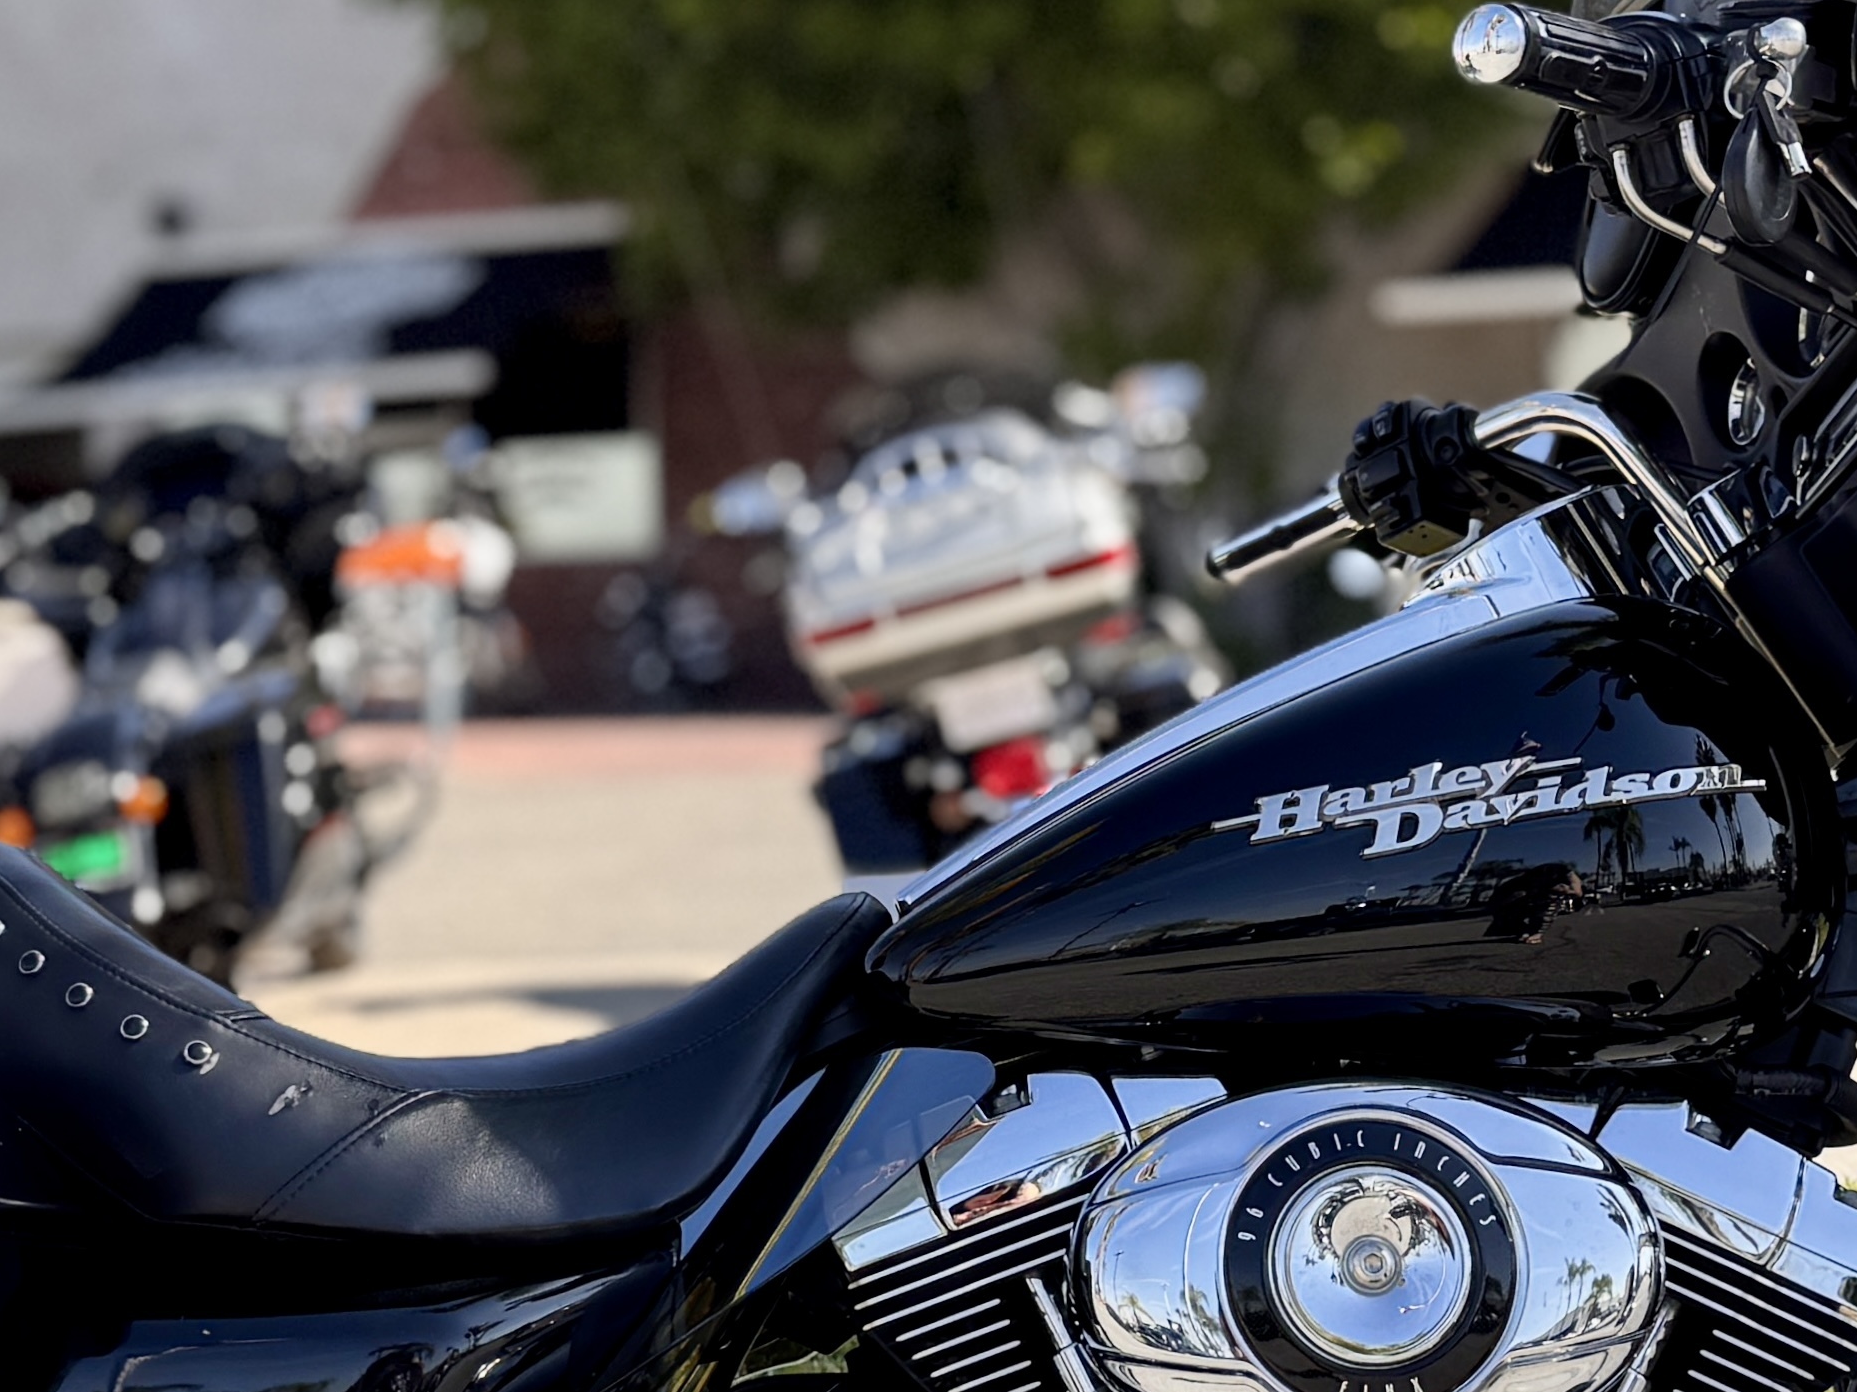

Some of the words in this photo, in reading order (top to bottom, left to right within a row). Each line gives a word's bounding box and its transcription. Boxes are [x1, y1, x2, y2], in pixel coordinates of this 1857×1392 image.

[1249, 753, 1541, 845] Harley
[1360, 761, 1745, 860] Davidson
[1266, 1128, 1366, 1188] CUBIC
[1392, 1131, 1498, 1227] INCHES
